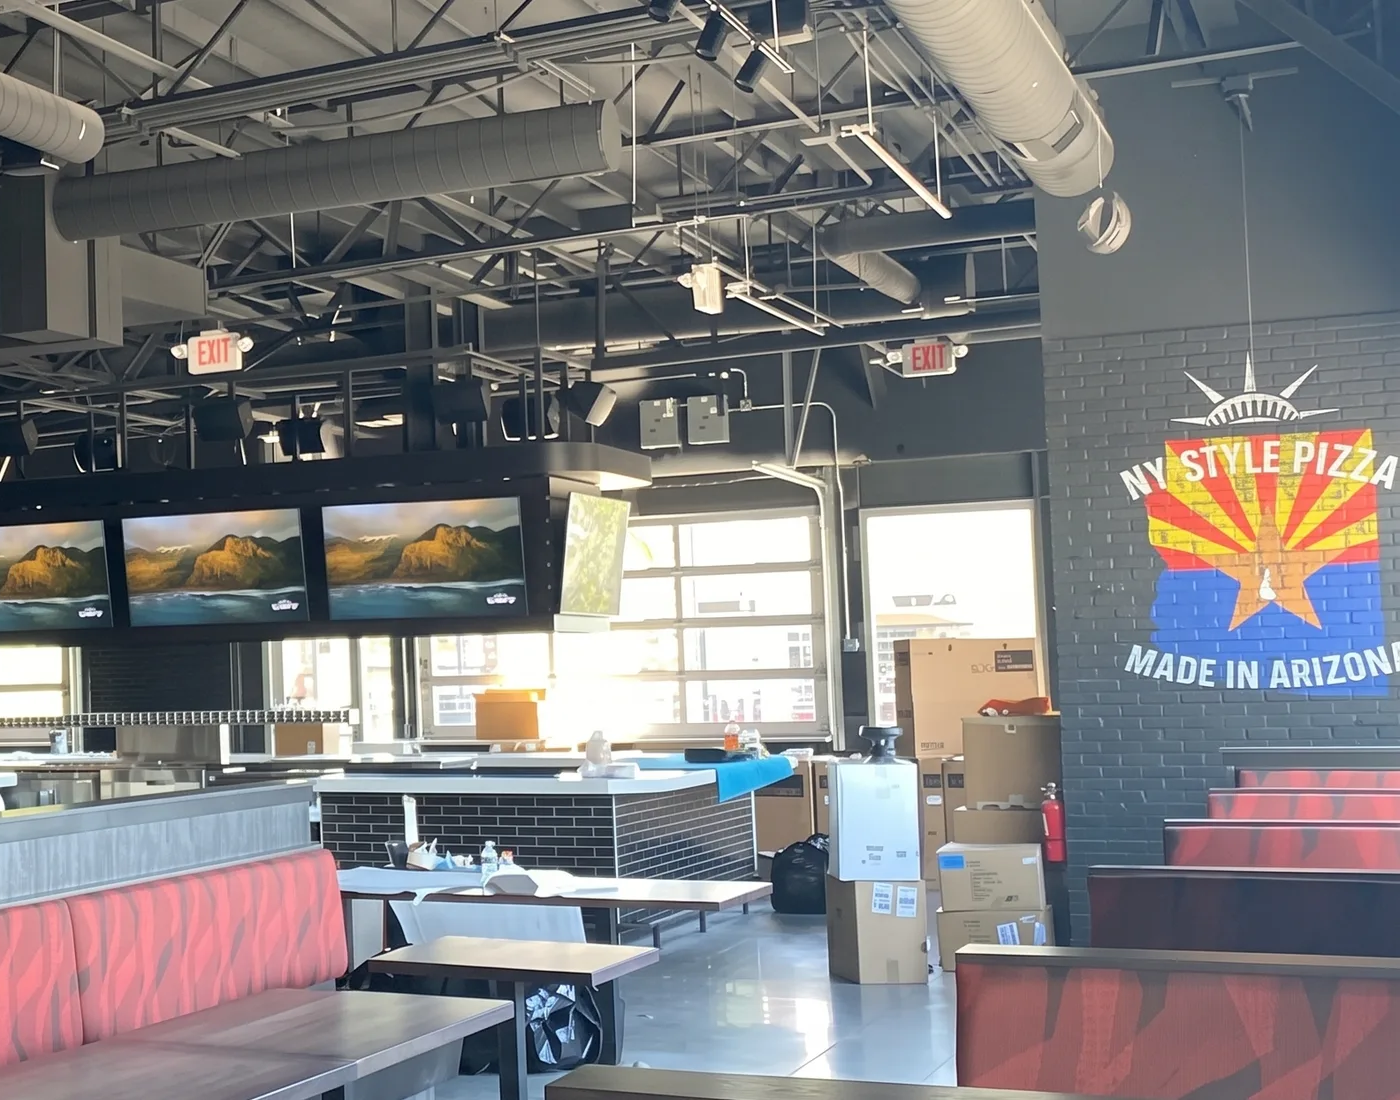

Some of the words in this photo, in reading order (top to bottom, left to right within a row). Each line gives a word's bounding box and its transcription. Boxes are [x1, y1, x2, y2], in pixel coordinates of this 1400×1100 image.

[197, 337, 231, 366] EXIT
[911, 344, 945, 371] EXIT
[1119, 457, 1167, 500] NY
[1180, 440, 1280, 482] STYLE
[1293, 440, 1399, 490] PIZZA
[1124, 644, 1217, 688] MADE
[1226, 659, 1259, 689] IN
